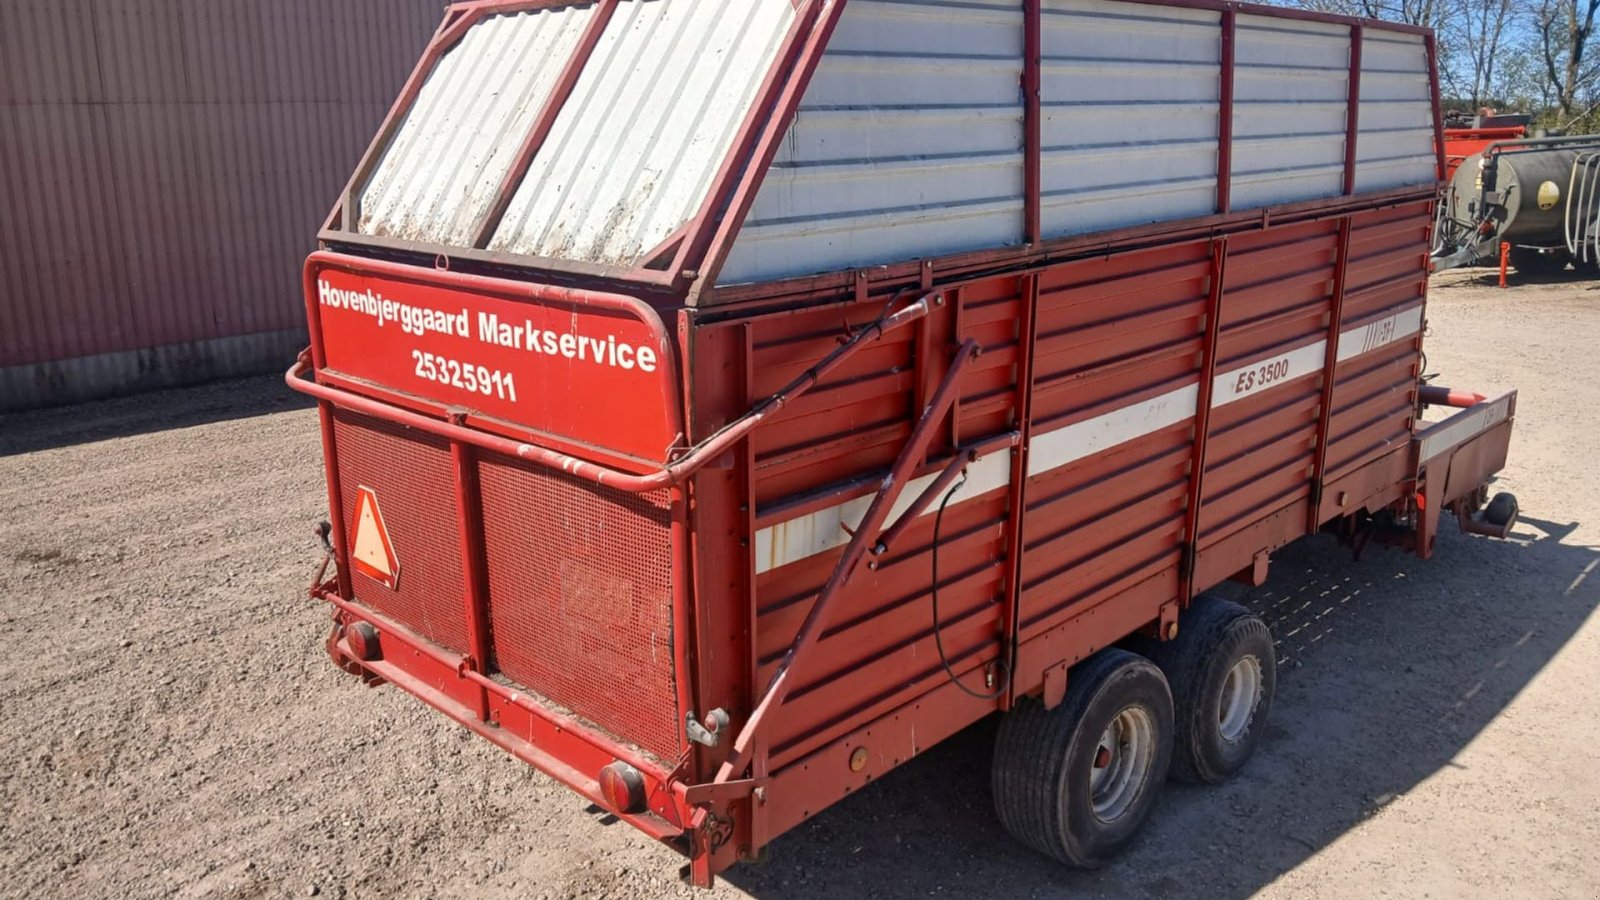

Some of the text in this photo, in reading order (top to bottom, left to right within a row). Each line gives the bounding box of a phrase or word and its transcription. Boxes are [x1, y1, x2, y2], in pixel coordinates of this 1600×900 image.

[317, 279, 658, 373] Hovenbjerggaard Markservice
[411, 349, 517, 402] 25325911
[1234, 358, 1289, 394] ES 3500
